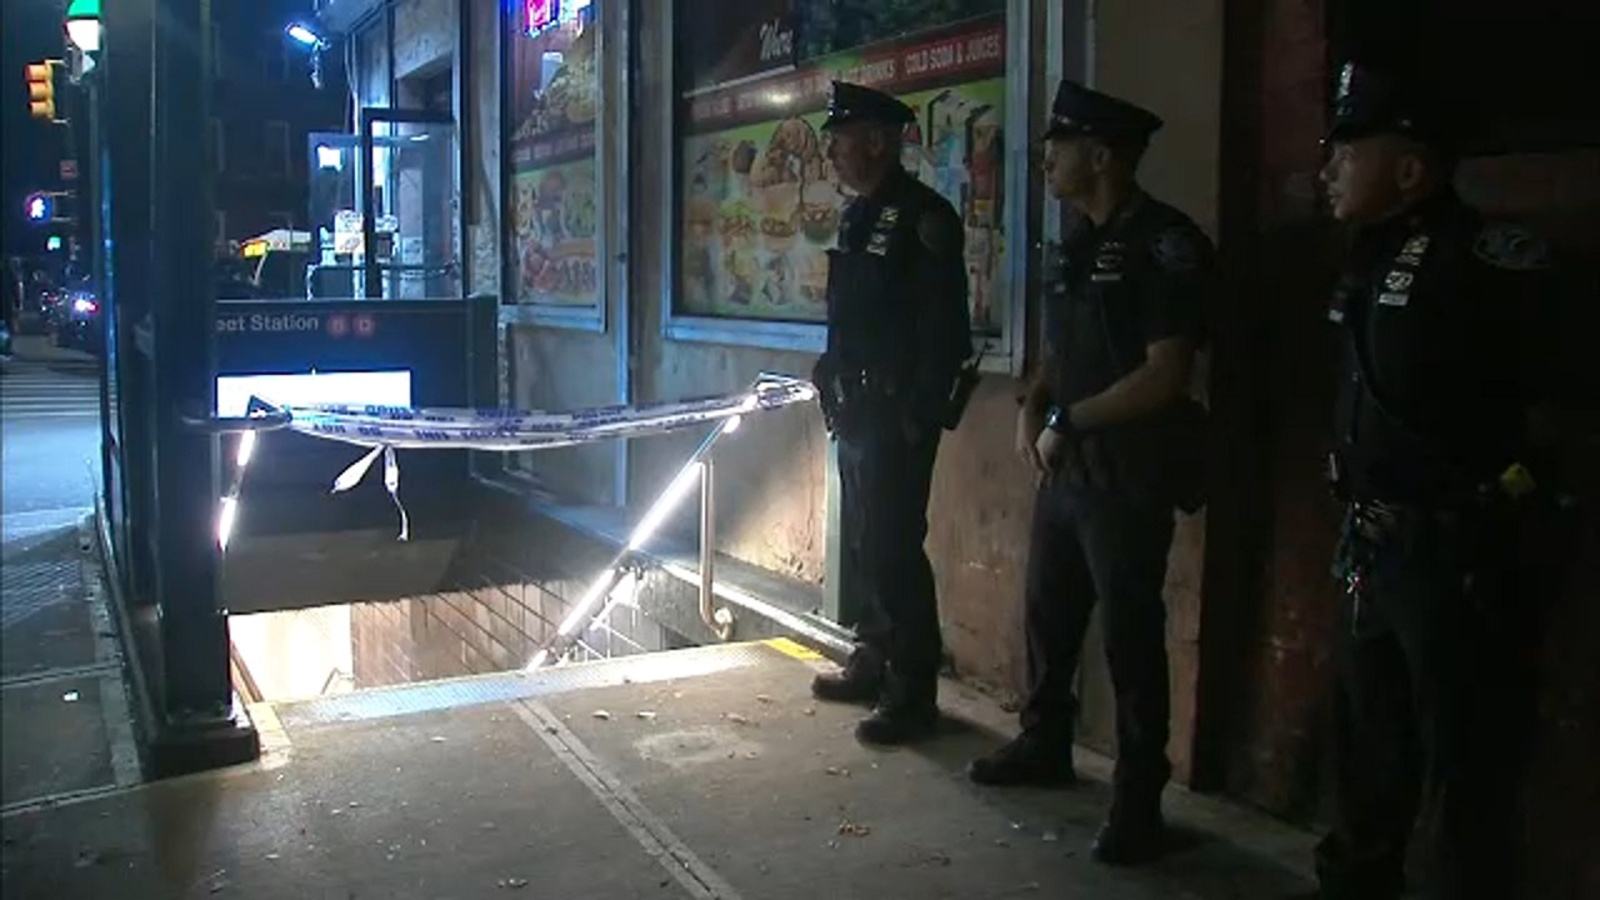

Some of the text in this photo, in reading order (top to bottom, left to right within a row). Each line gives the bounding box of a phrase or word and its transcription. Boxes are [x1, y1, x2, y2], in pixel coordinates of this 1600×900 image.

[905, 34, 1000, 75] COLD SODA & JUICES
[250, 314, 319, 332] Station
